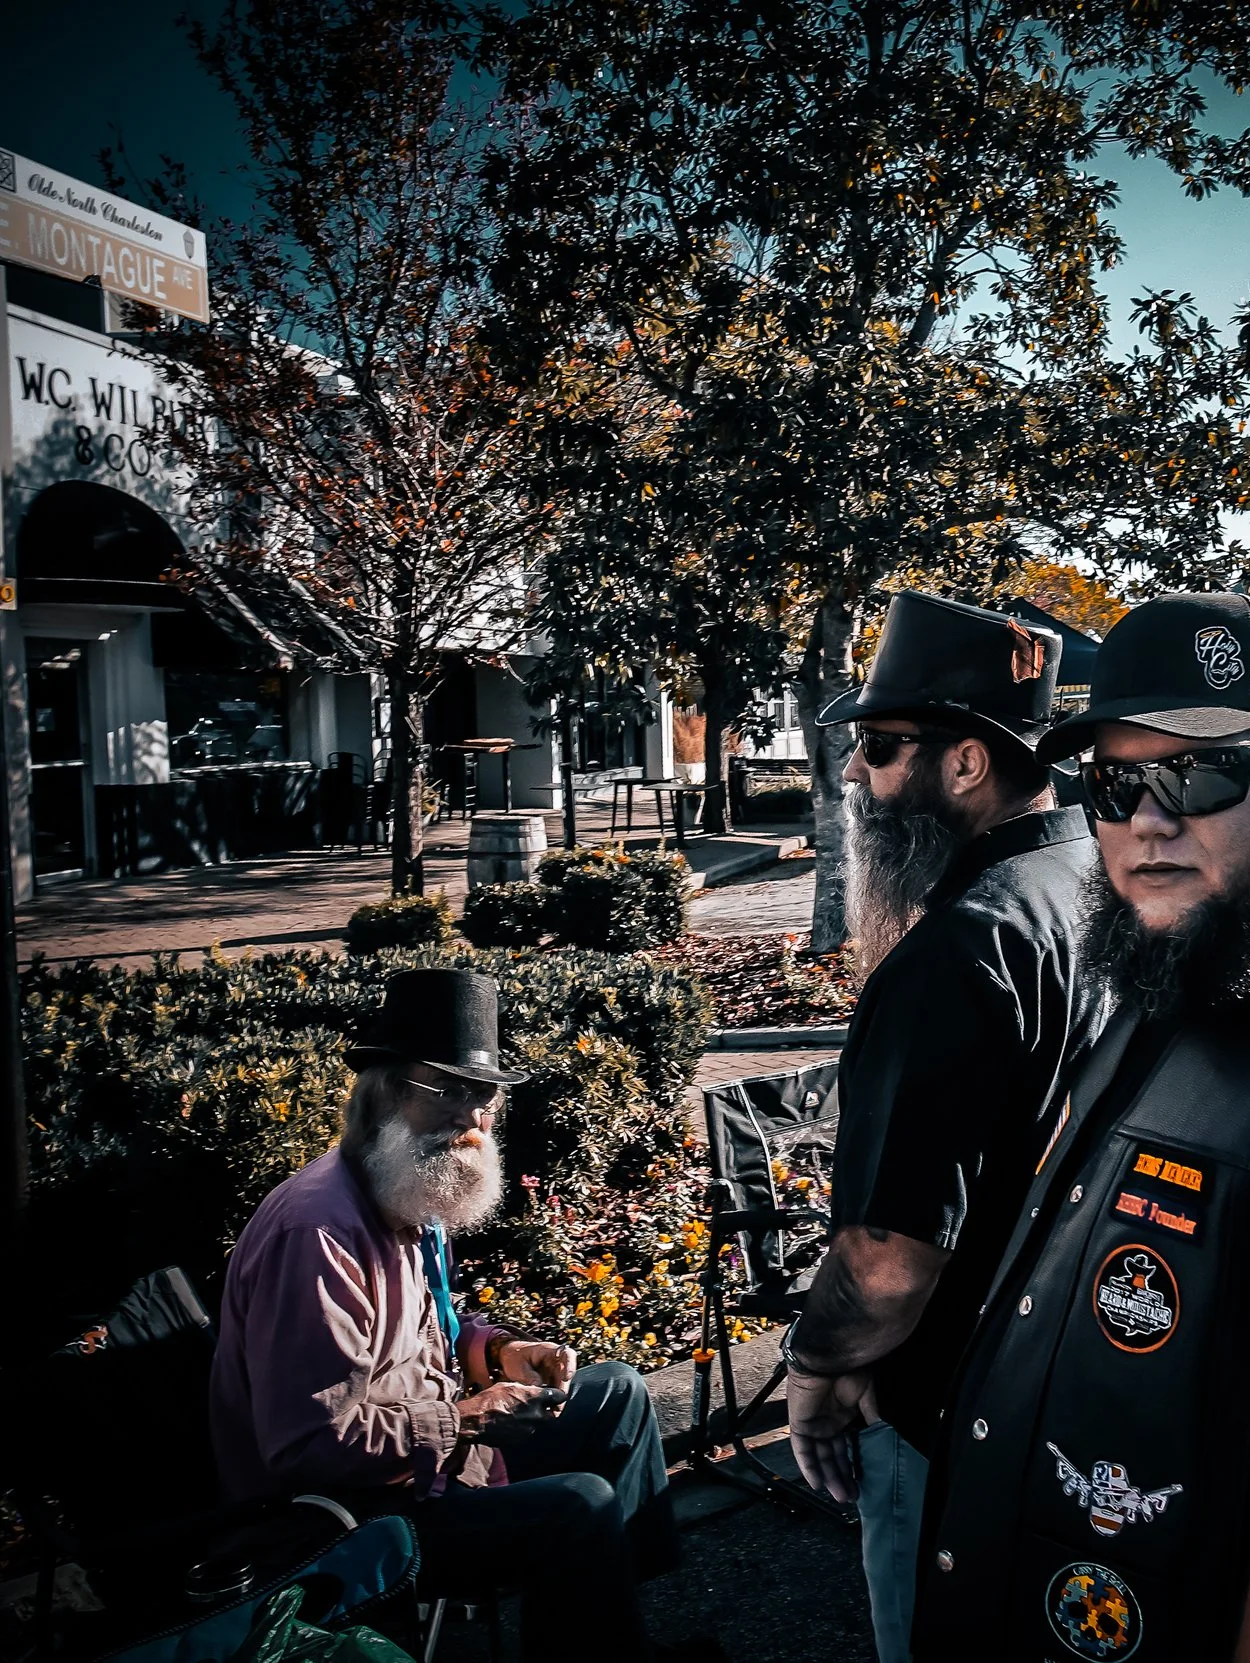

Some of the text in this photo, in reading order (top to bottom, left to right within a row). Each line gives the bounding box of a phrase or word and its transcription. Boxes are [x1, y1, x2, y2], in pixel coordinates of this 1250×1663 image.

[27, 173, 163, 241] Olde North Charleston
[28, 212, 167, 300] MONTAGUE
[74, 424, 94, 466] &
